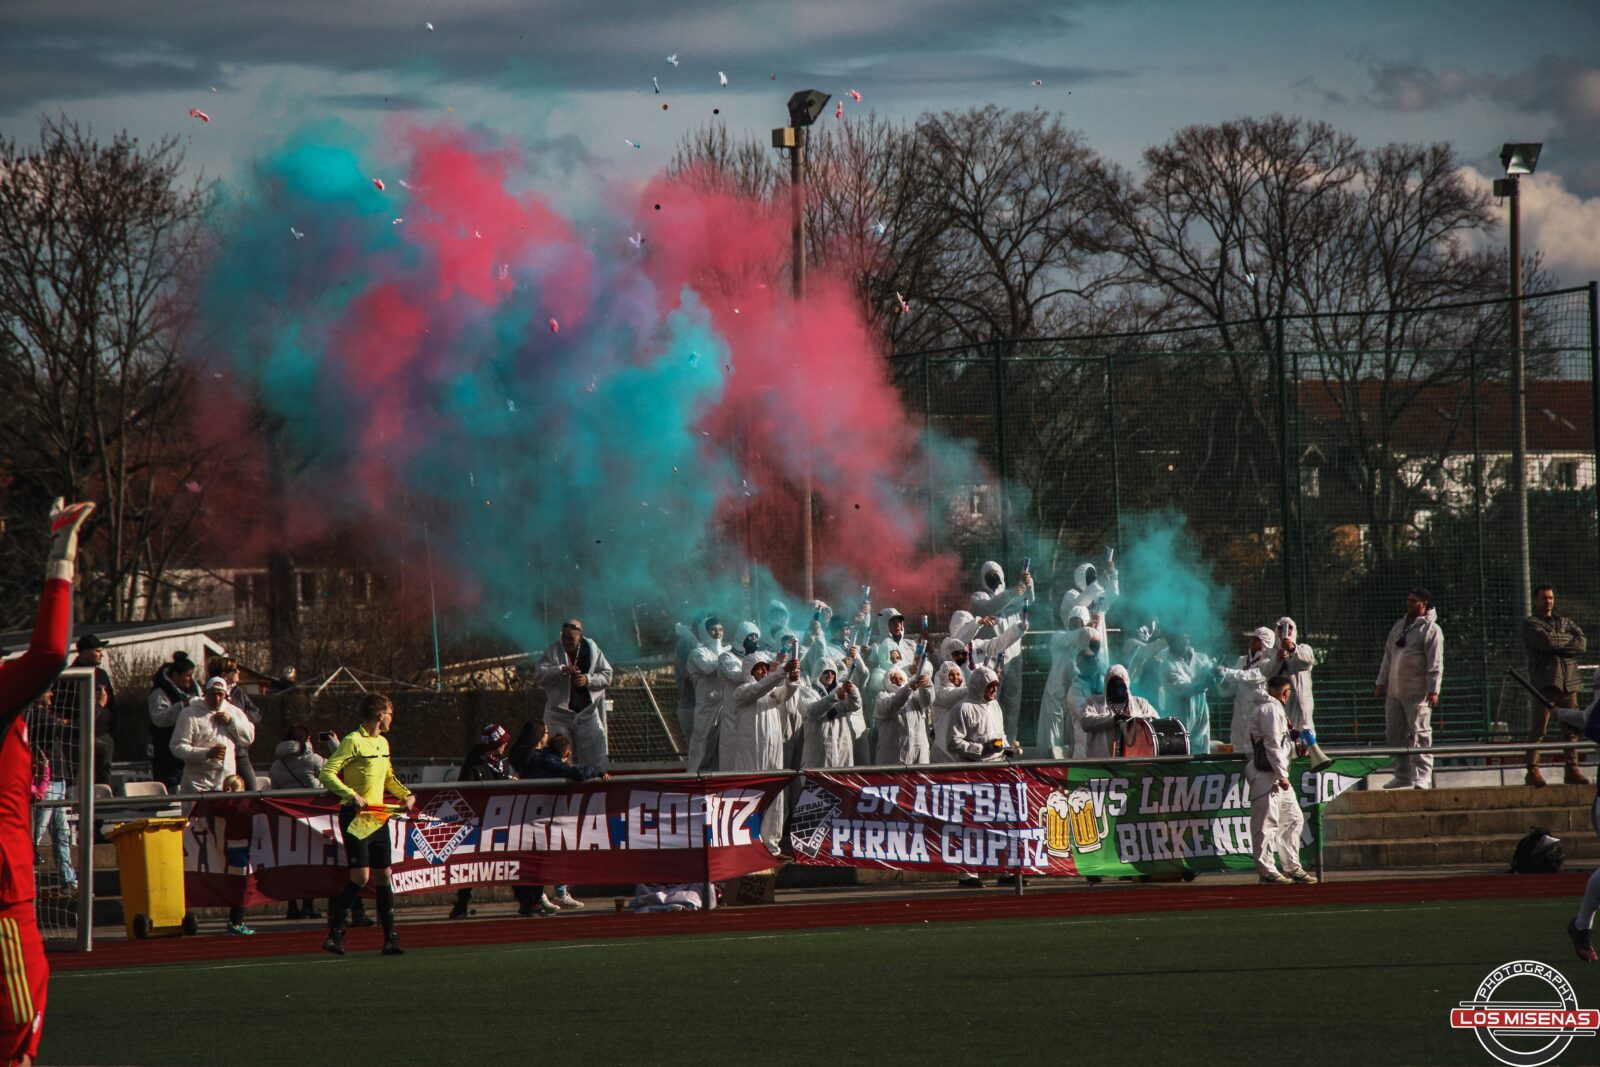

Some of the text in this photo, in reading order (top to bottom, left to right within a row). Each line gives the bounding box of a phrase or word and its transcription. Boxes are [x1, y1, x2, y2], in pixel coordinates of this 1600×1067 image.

[857, 782, 1028, 822] SV AUFBAU
[1090, 778, 1129, 818] VS
[1139, 773, 1251, 814] LIMBA
[249, 813, 406, 871] AUFU
[480, 792, 611, 852] PIRNA
[628, 789, 765, 849] COPITZ
[415, 833, 435, 864] PIRNA
[441, 827, 470, 861] COPITZ
[831, 818, 1049, 867] PIRNA COPITZ
[390, 860, 520, 894] CHSISCHE SCHWEIZ
